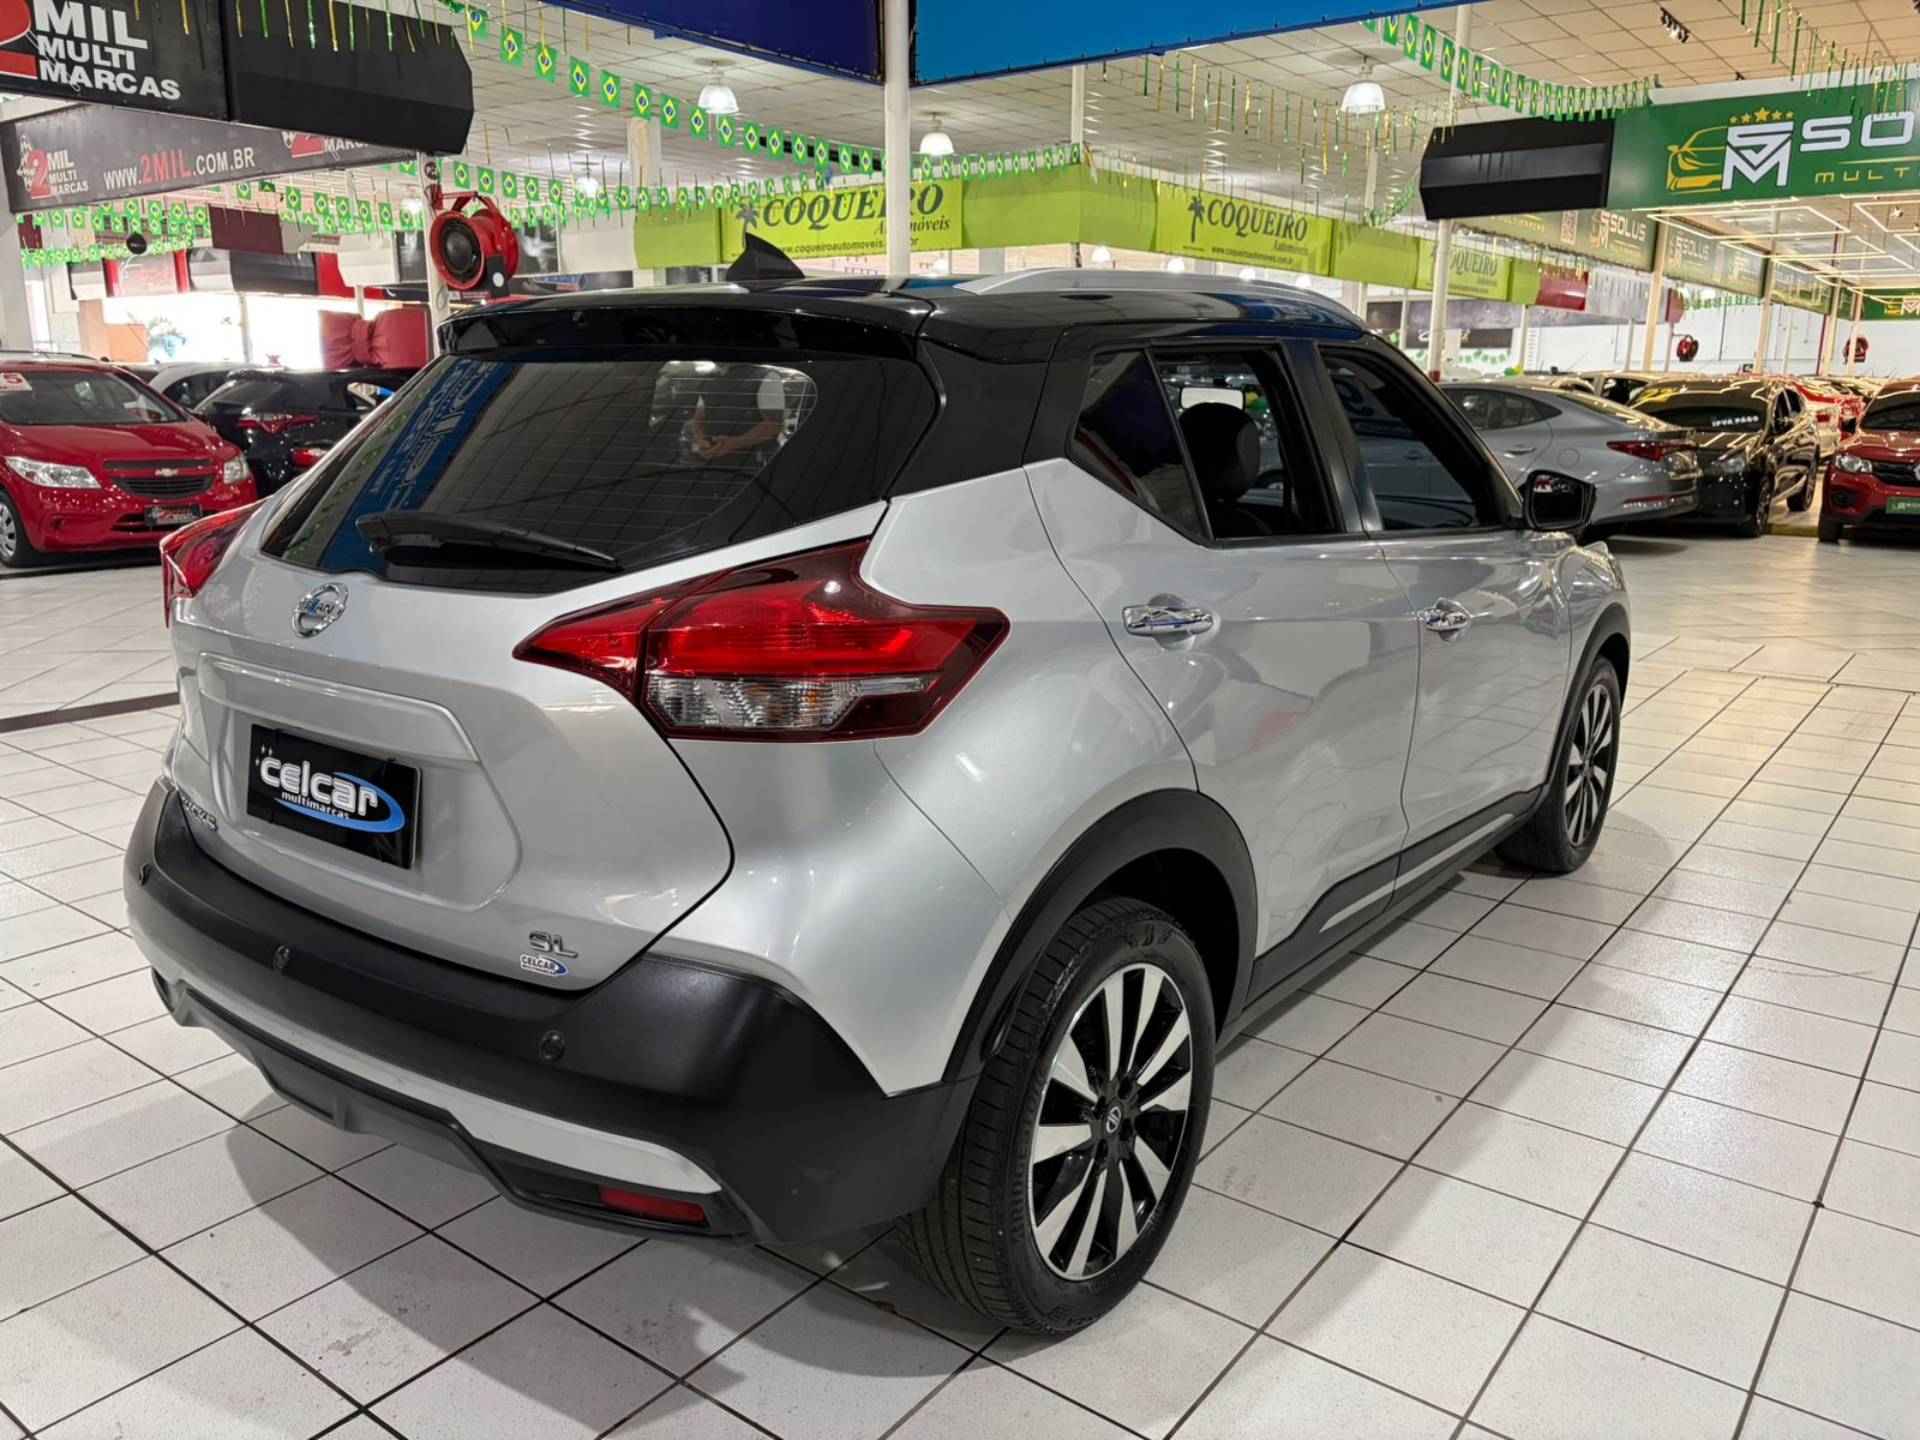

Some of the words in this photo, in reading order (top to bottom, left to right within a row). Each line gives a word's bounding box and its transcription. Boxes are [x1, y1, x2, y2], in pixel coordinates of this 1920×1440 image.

[33, 0, 148, 49] MIL
[37, 34, 136, 71] MULTI
[39, 59, 181, 100] MARCAS
[46, 149, 75, 171] MIL
[103, 147, 256, 190] WWW.2MIL.COM.BR
[48, 169, 78, 185] MULTI
[52, 180, 89, 197] MARCAS
[1207, 199, 1308, 242] COQUEIRO
[260, 756, 378, 817] celcar
[281, 791, 350, 821] multimarcas
[528, 931, 578, 959] SL
[521, 956, 557, 970] CELCAR
